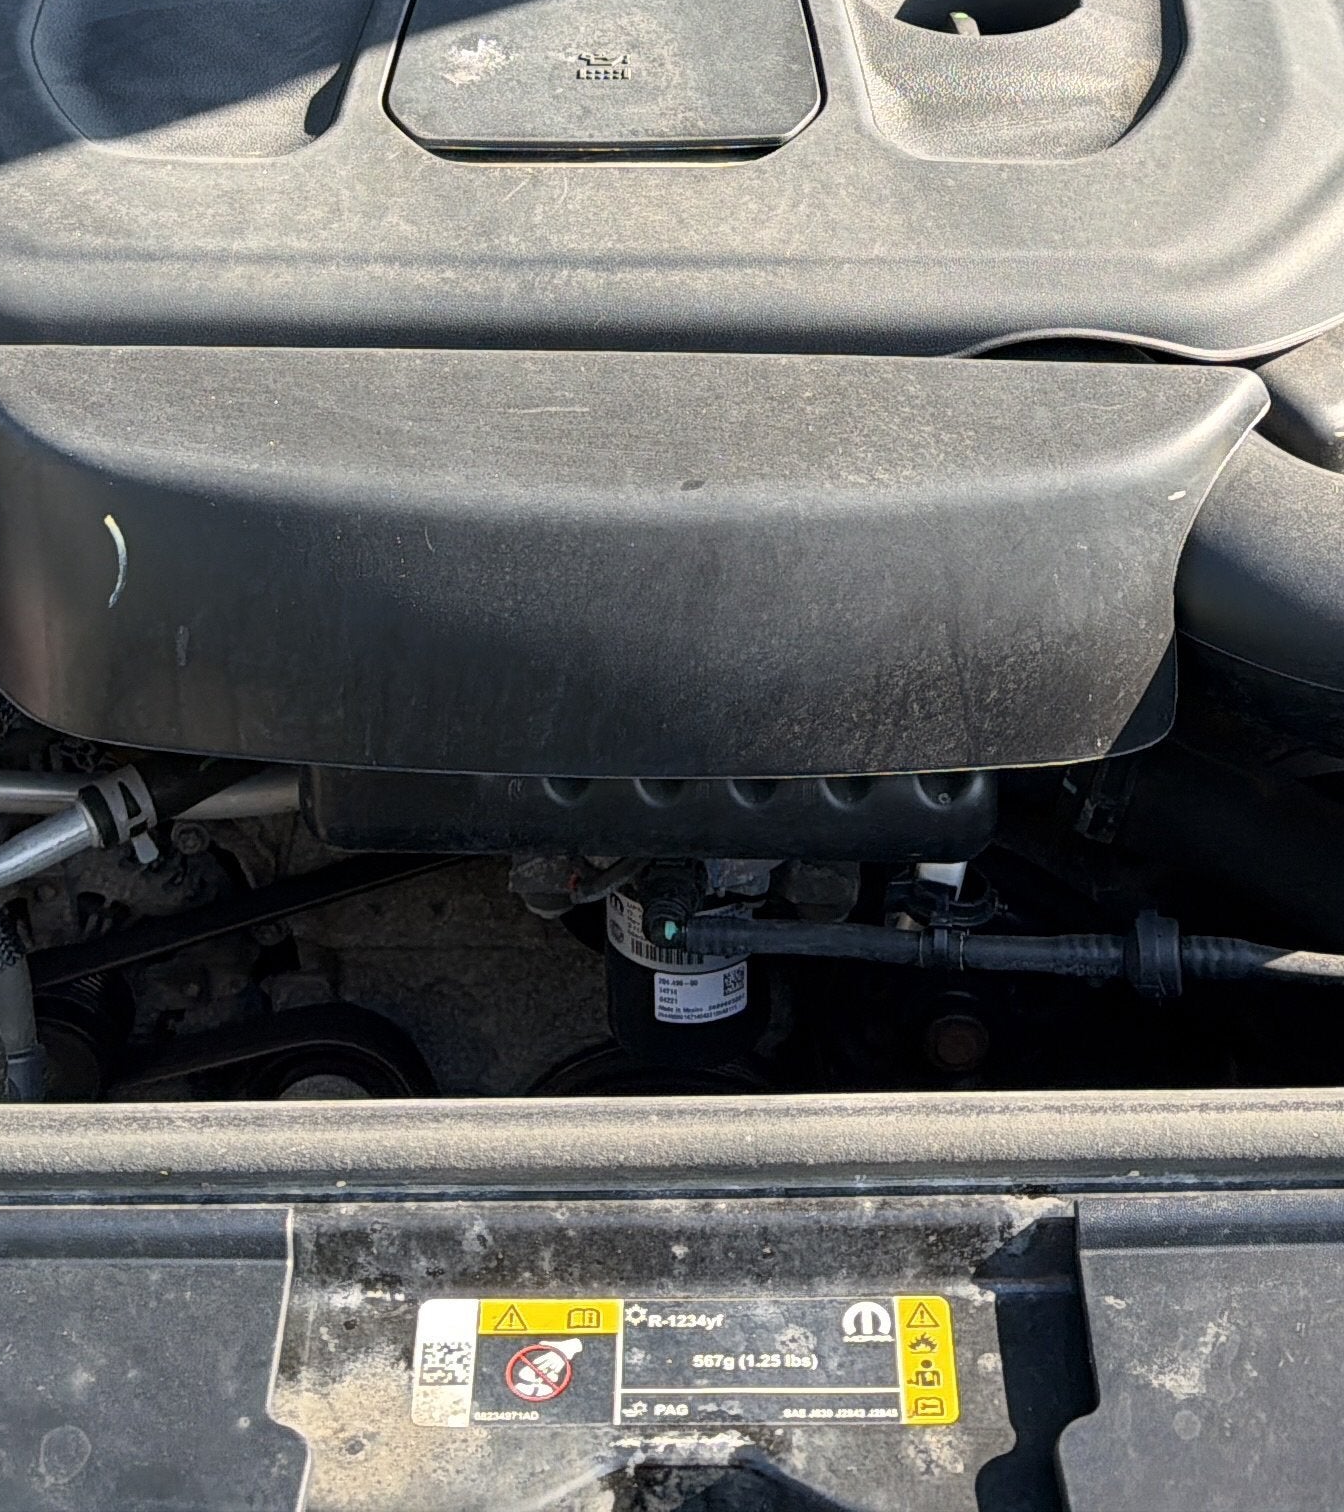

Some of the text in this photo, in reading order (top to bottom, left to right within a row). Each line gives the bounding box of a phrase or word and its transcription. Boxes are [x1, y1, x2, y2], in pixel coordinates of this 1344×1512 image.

[647, 1313, 723, 1330] R-1234yf
[692, 1353, 819, 1370] 567g (1.25 lbs)
[653, 1403, 689, 1417] PAG
[782, 1408, 807, 1419] SAE
